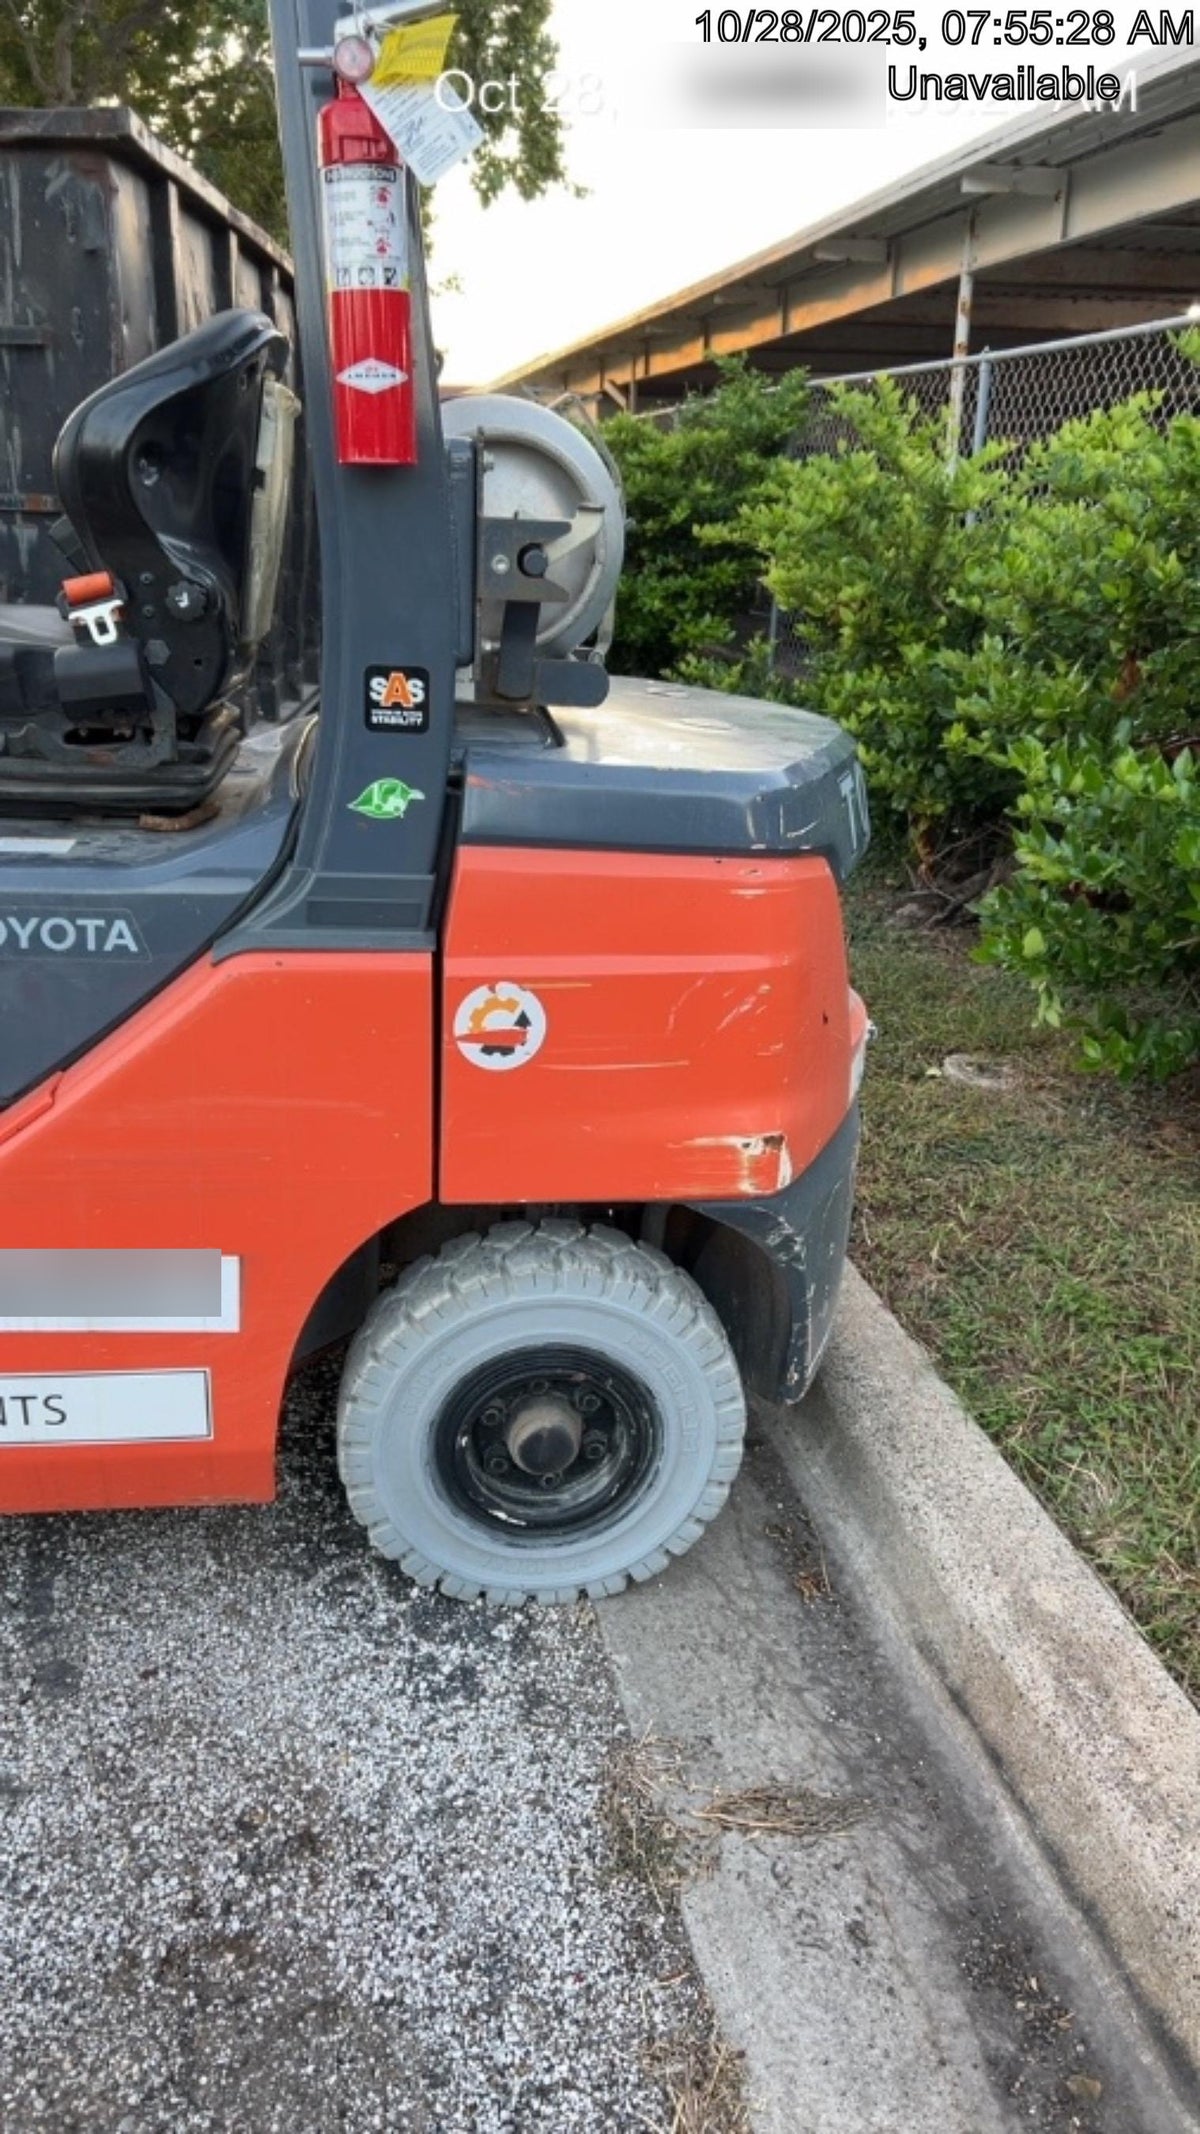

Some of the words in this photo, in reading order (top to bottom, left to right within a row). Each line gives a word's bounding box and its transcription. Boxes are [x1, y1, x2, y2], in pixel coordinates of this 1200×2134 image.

[369, 671, 426, 708] SAS
[0, 916, 138, 952] YOTA
[0, 1393, 68, 1426] TS
